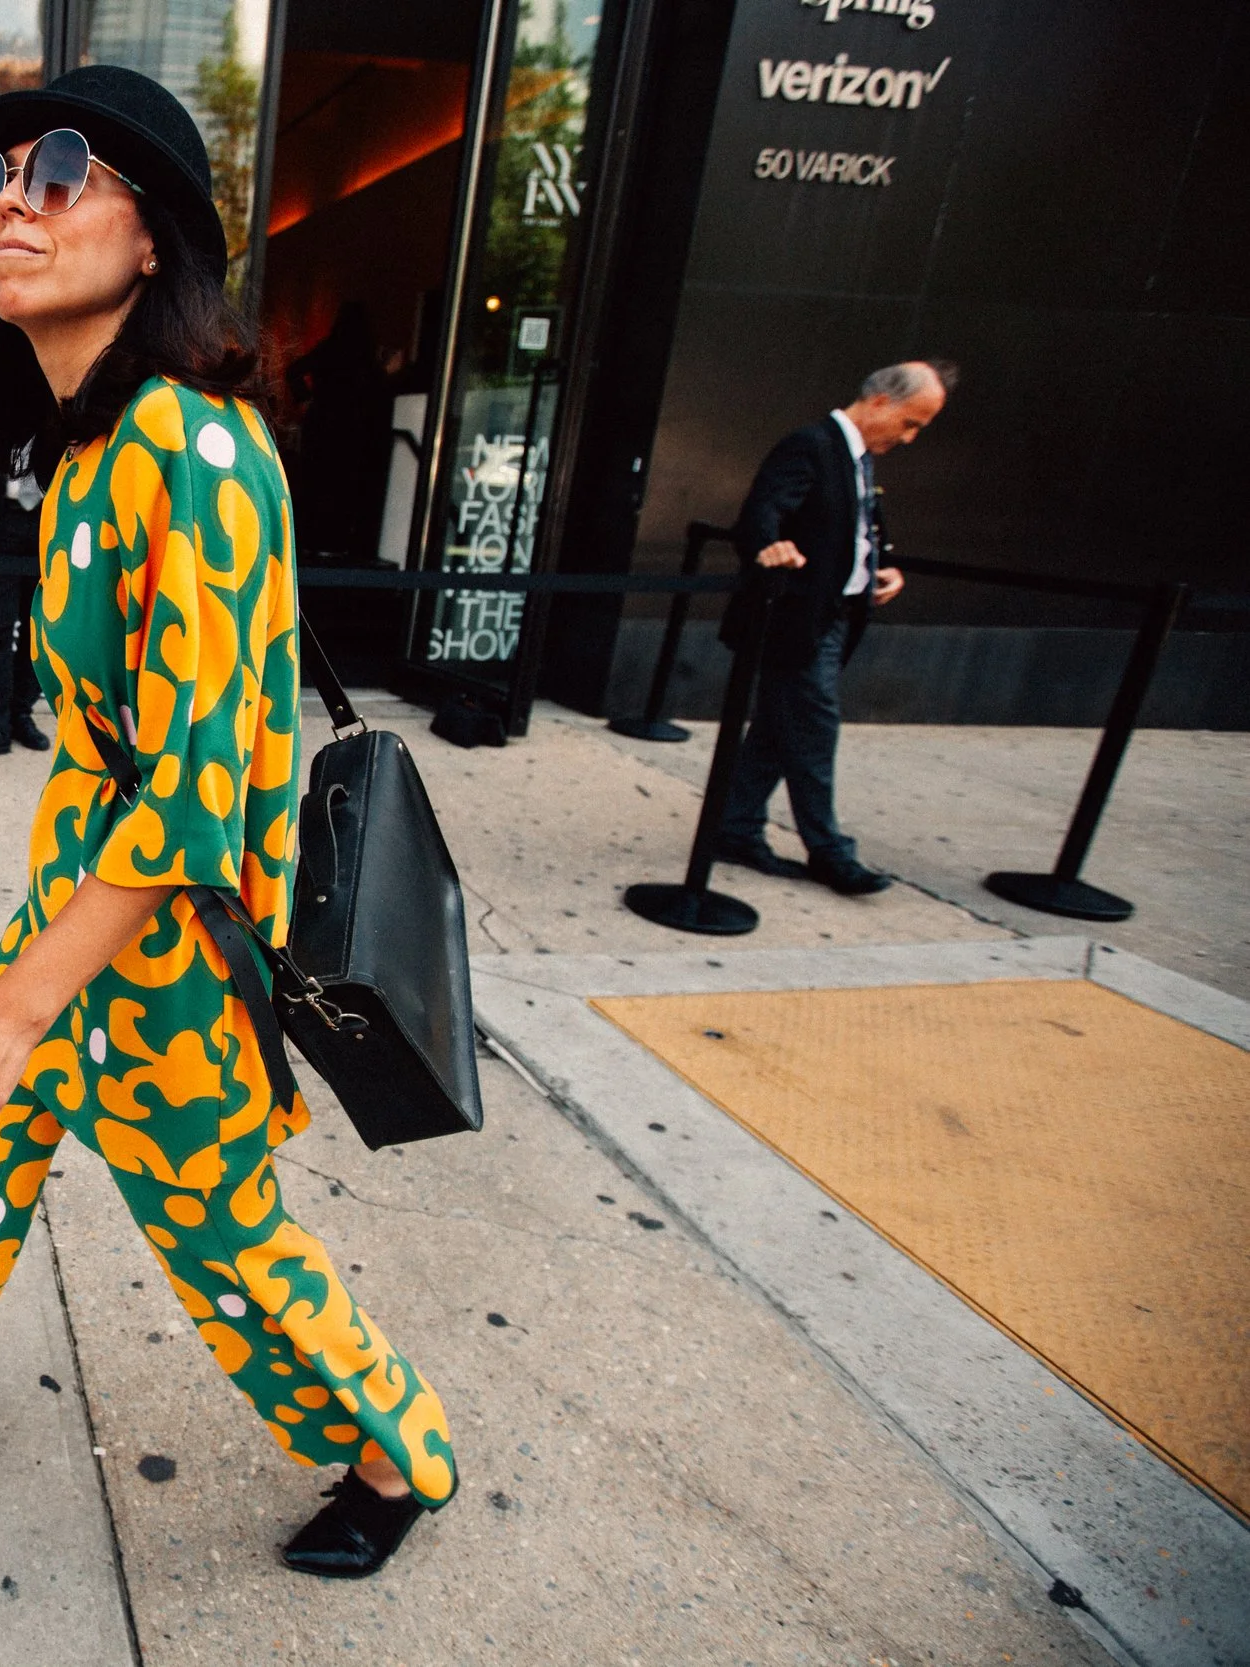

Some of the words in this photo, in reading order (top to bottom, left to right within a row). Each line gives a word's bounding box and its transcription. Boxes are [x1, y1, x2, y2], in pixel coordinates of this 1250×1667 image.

[758, 53, 924, 109] verizon
[754, 147, 794, 180] 50
[795, 150, 897, 187] VARICK
[457, 597, 525, 631] THE
